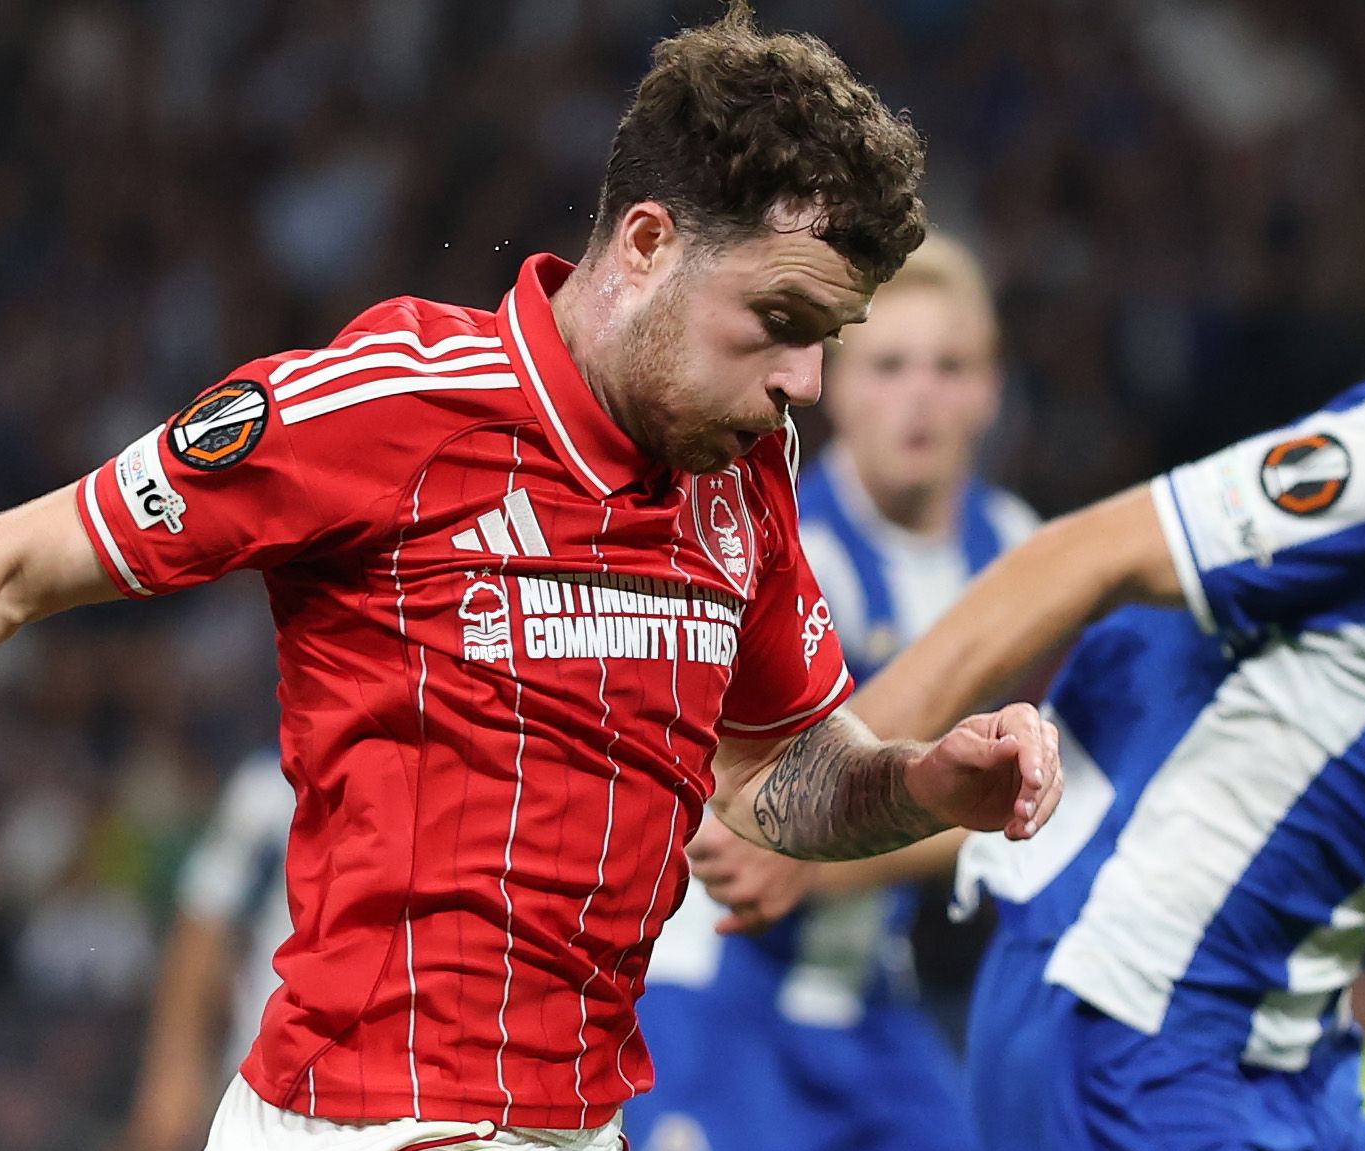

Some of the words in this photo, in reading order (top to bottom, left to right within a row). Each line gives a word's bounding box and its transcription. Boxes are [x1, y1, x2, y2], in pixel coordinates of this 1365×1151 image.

[517, 571, 687, 616] NOTTINGHAM
[464, 644, 510, 663] FOREST
[523, 615, 678, 660] COMMUNITY
